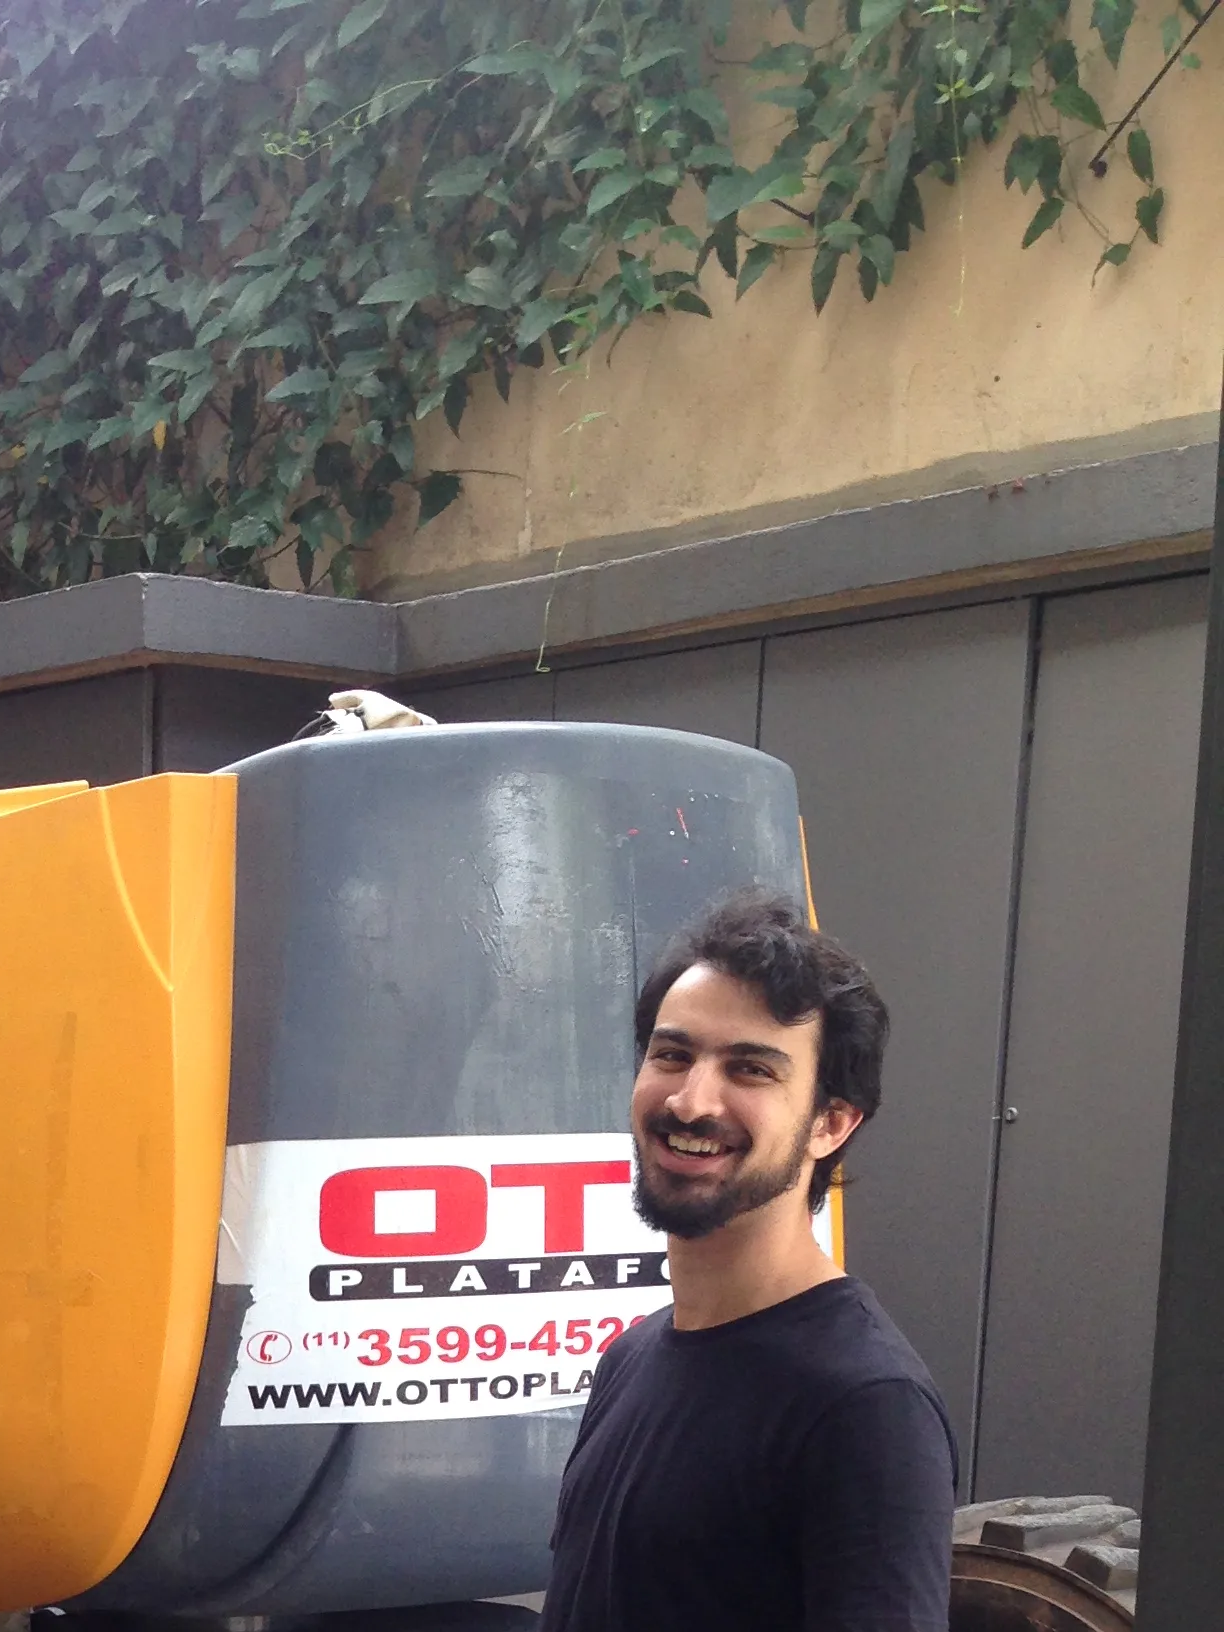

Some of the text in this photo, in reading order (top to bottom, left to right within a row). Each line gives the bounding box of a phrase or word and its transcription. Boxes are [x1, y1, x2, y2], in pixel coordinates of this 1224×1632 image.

[319, 1159, 632, 1257] OT
[328, 1257, 671, 1297] PLATAF
[302, 1315, 647, 1367] (11) 3599-452
[248, 1370, 594, 1410] WWW.OTTOPLA
